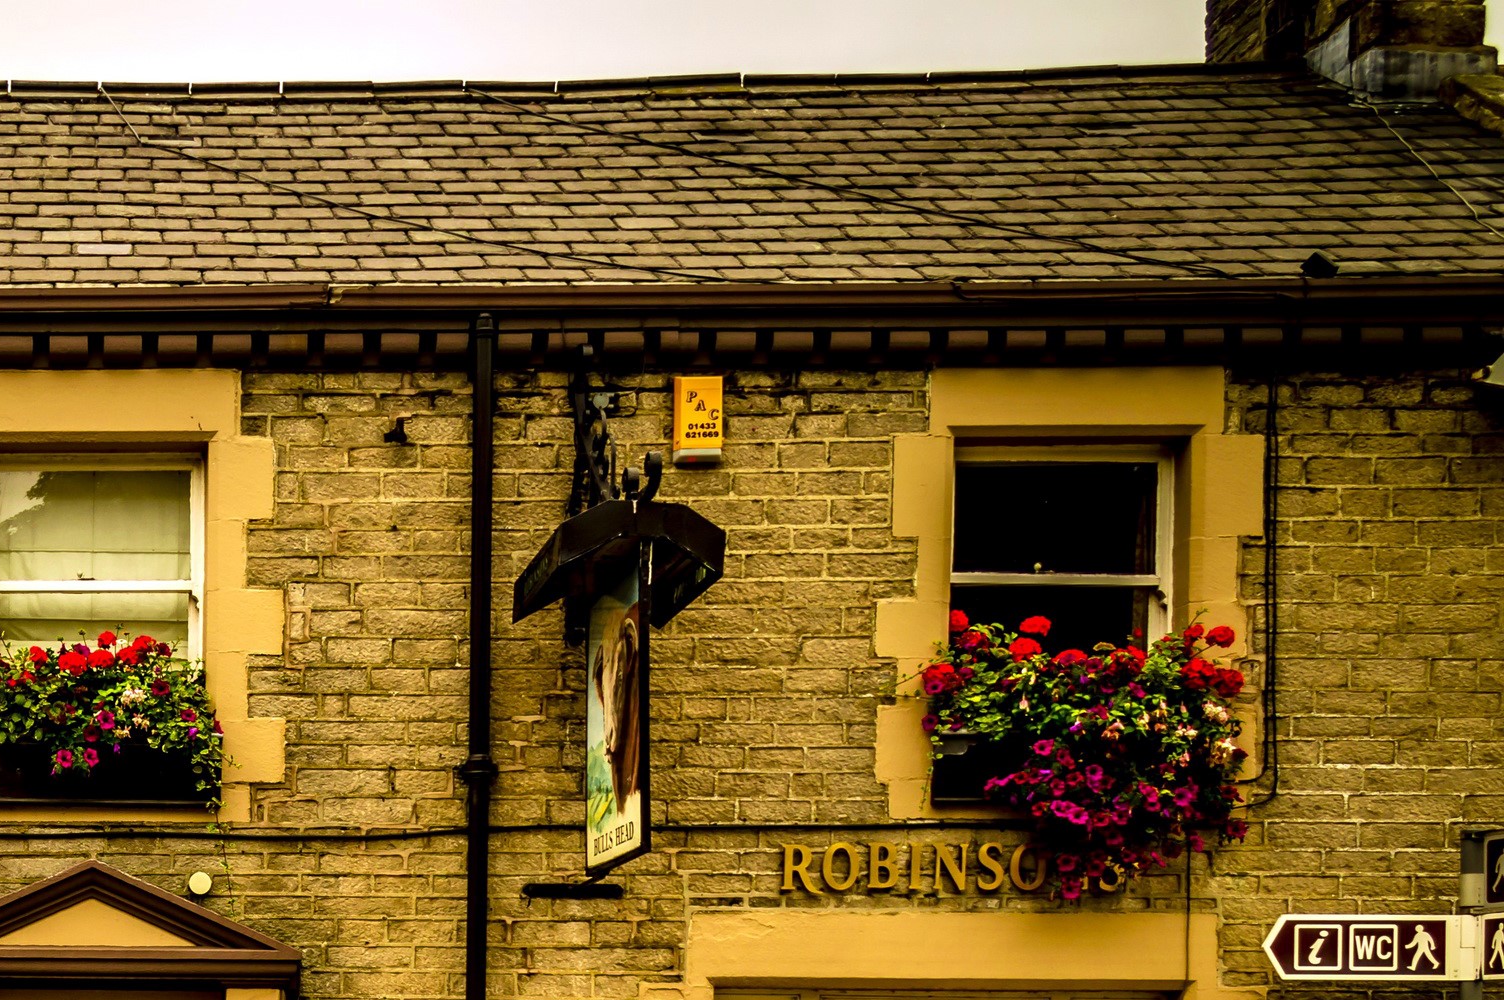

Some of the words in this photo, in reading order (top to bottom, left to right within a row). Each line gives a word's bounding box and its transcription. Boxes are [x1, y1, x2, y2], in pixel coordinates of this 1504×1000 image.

[688, 422, 716, 430] 01433
[593, 831, 613, 856] BULLS
[615, 821, 634, 846] HEAD
[780, 842, 1121, 894] ROBINSO
[1354, 935, 1392, 960] WC
